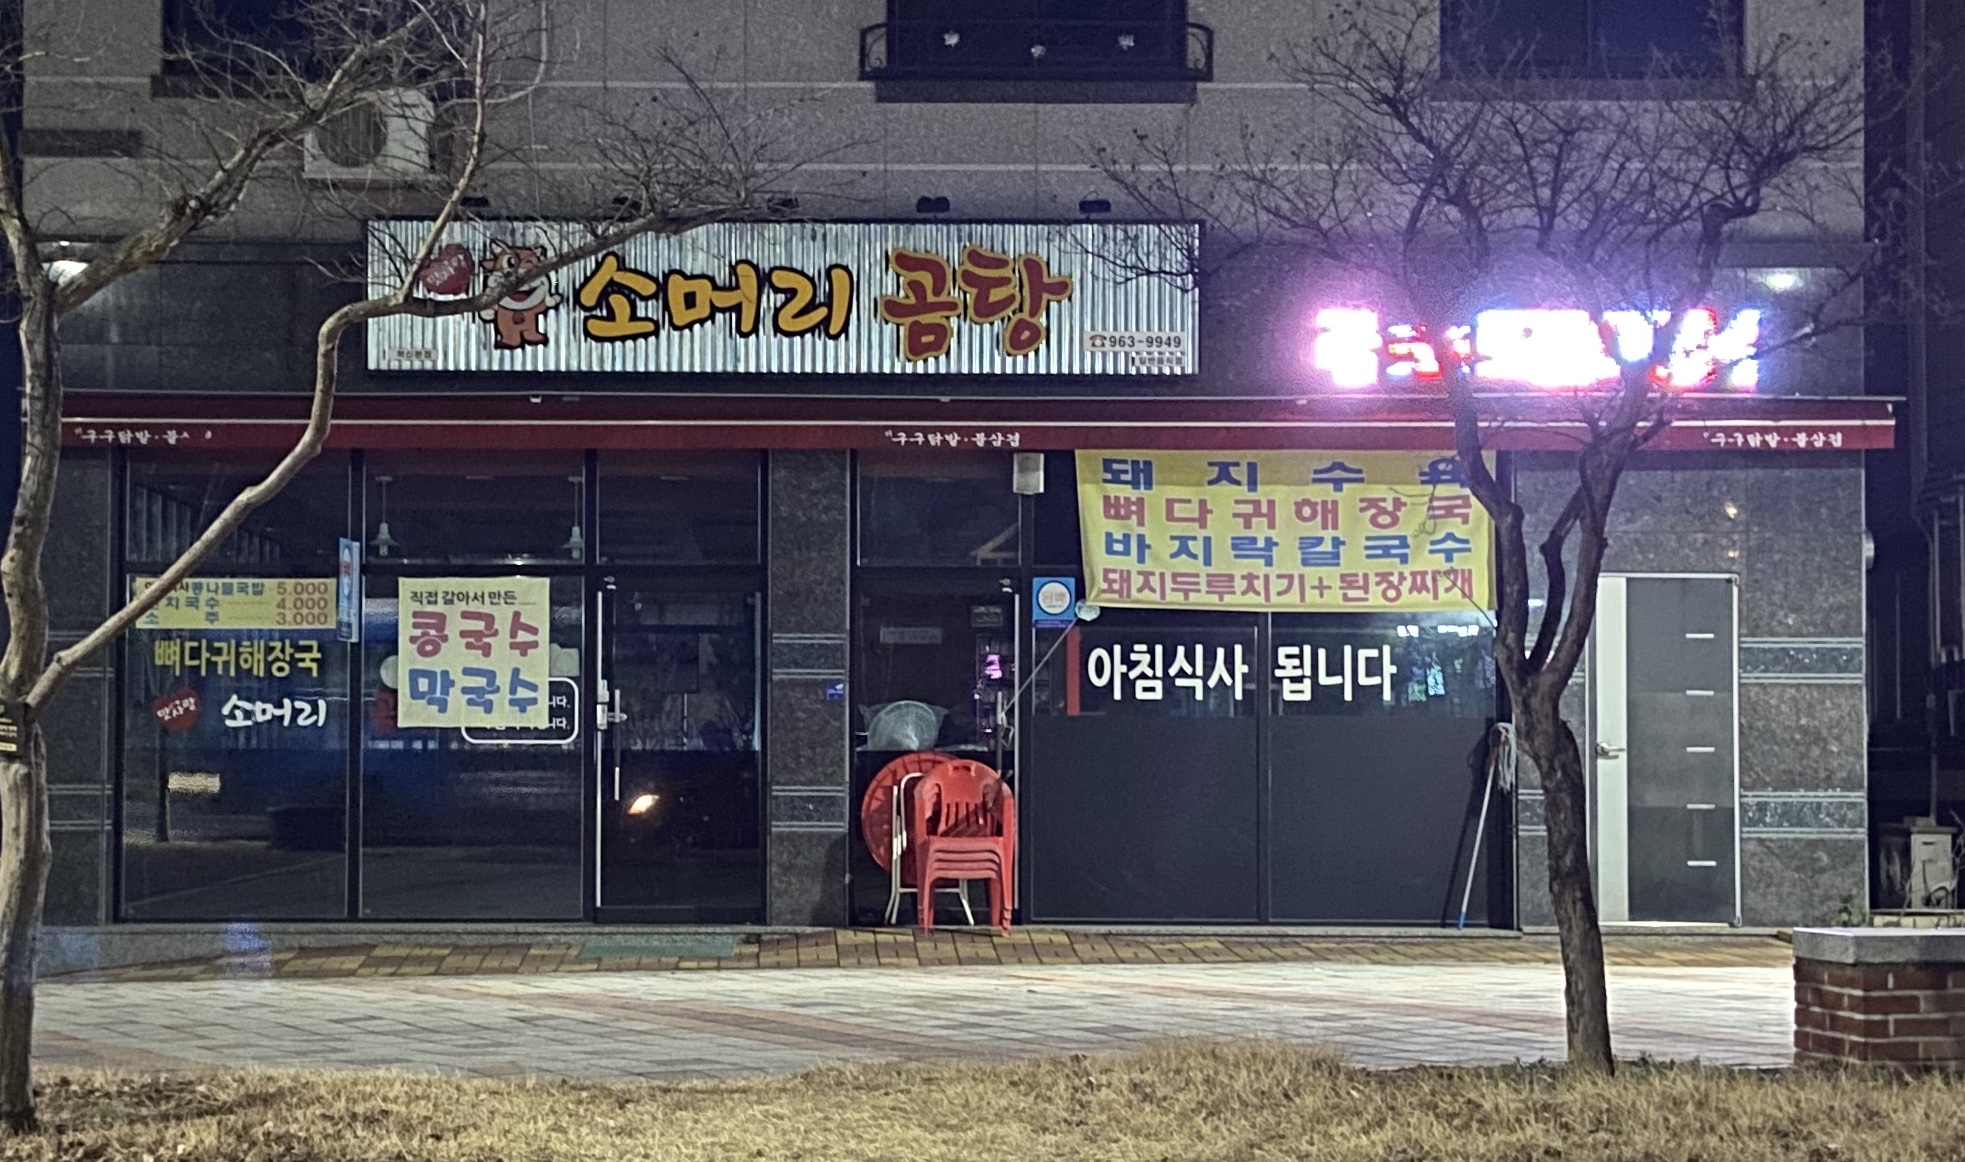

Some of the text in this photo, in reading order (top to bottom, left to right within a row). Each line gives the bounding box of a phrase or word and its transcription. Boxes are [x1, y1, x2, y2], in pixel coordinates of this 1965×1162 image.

[579, 244, 1074, 362] 소머리 곰탕
[1109, 335, 1182, 349] 963-9949
[1104, 531, 1474, 567] 바지락칼국수
[275, 597, 328, 611] 4.000
[276, 581, 328, 596] 5.000
[410, 591, 518, 605] 직접 갈아서 만든
[275, 611, 328, 626] 3.000
[409, 610, 540, 658] 콩국수
[154, 638, 322, 677] 뼈다귀해장국
[1088, 644, 1398, 702] 아침식사 됩니다
[408, 667, 540, 714] 막국수
[221, 693, 327, 727] 소머리
